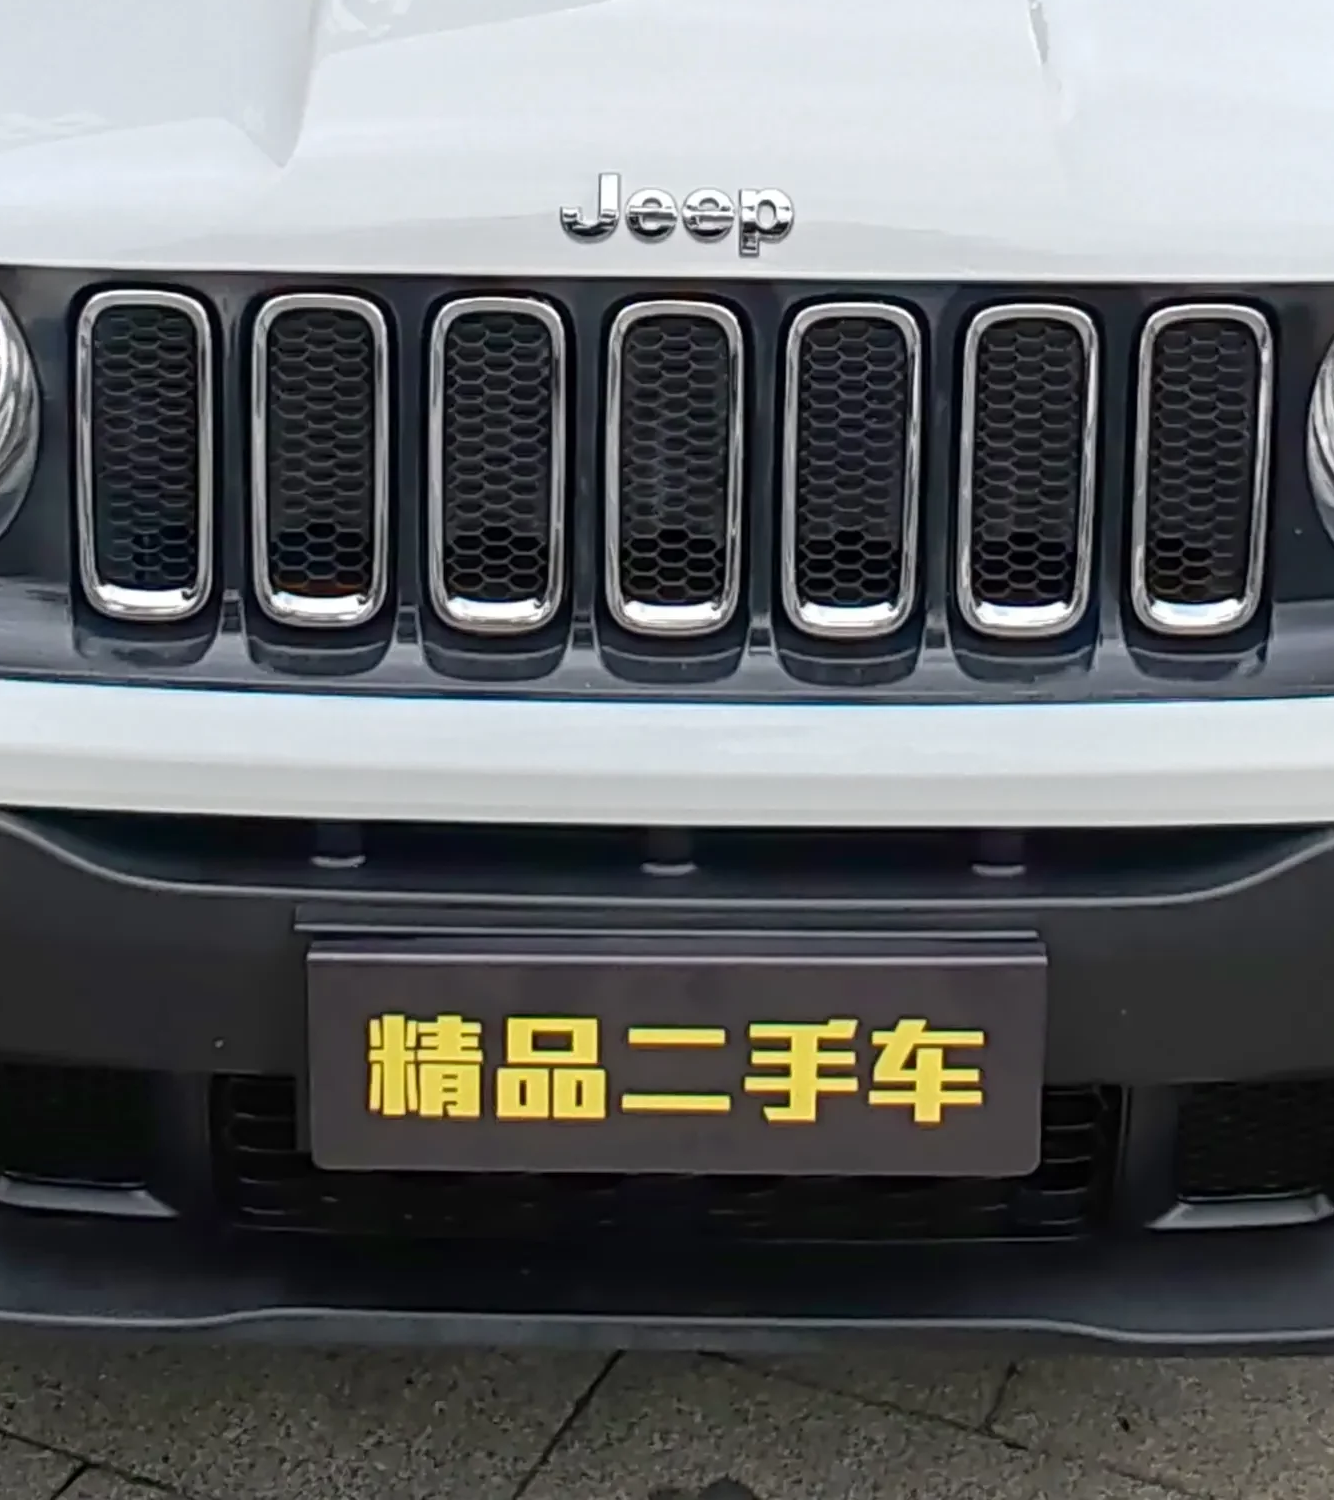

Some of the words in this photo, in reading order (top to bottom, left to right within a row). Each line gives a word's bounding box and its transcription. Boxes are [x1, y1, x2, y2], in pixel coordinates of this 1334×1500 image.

[560, 172, 795, 257] Jeep
[368, 1014, 985, 1124] 精品二手车
